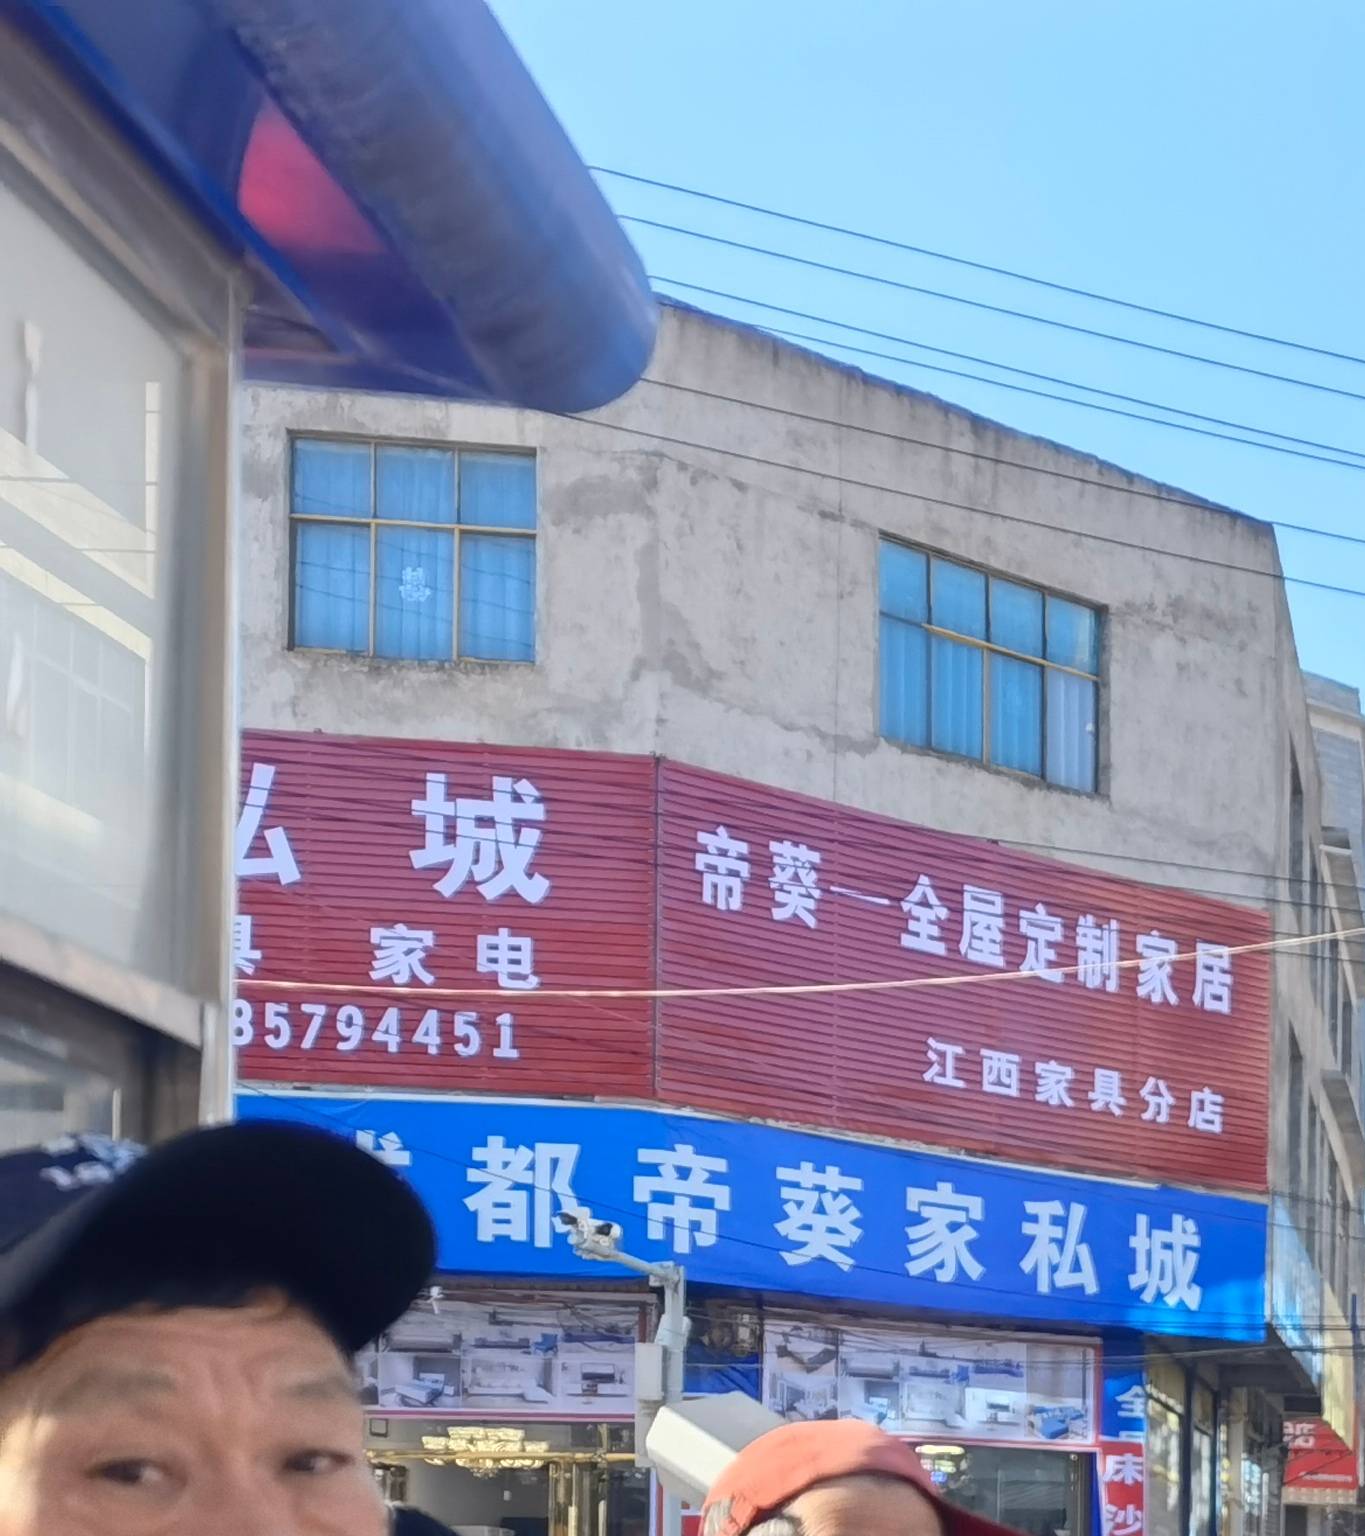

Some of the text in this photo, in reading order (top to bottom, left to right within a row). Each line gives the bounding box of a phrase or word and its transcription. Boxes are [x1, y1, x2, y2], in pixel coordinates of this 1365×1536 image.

[922, 1037, 1226, 1134] 江西家具分店
[355, 1130, 1203, 1312] 都帝葵家私城
[1103, 1453, 1143, 1485] 床
